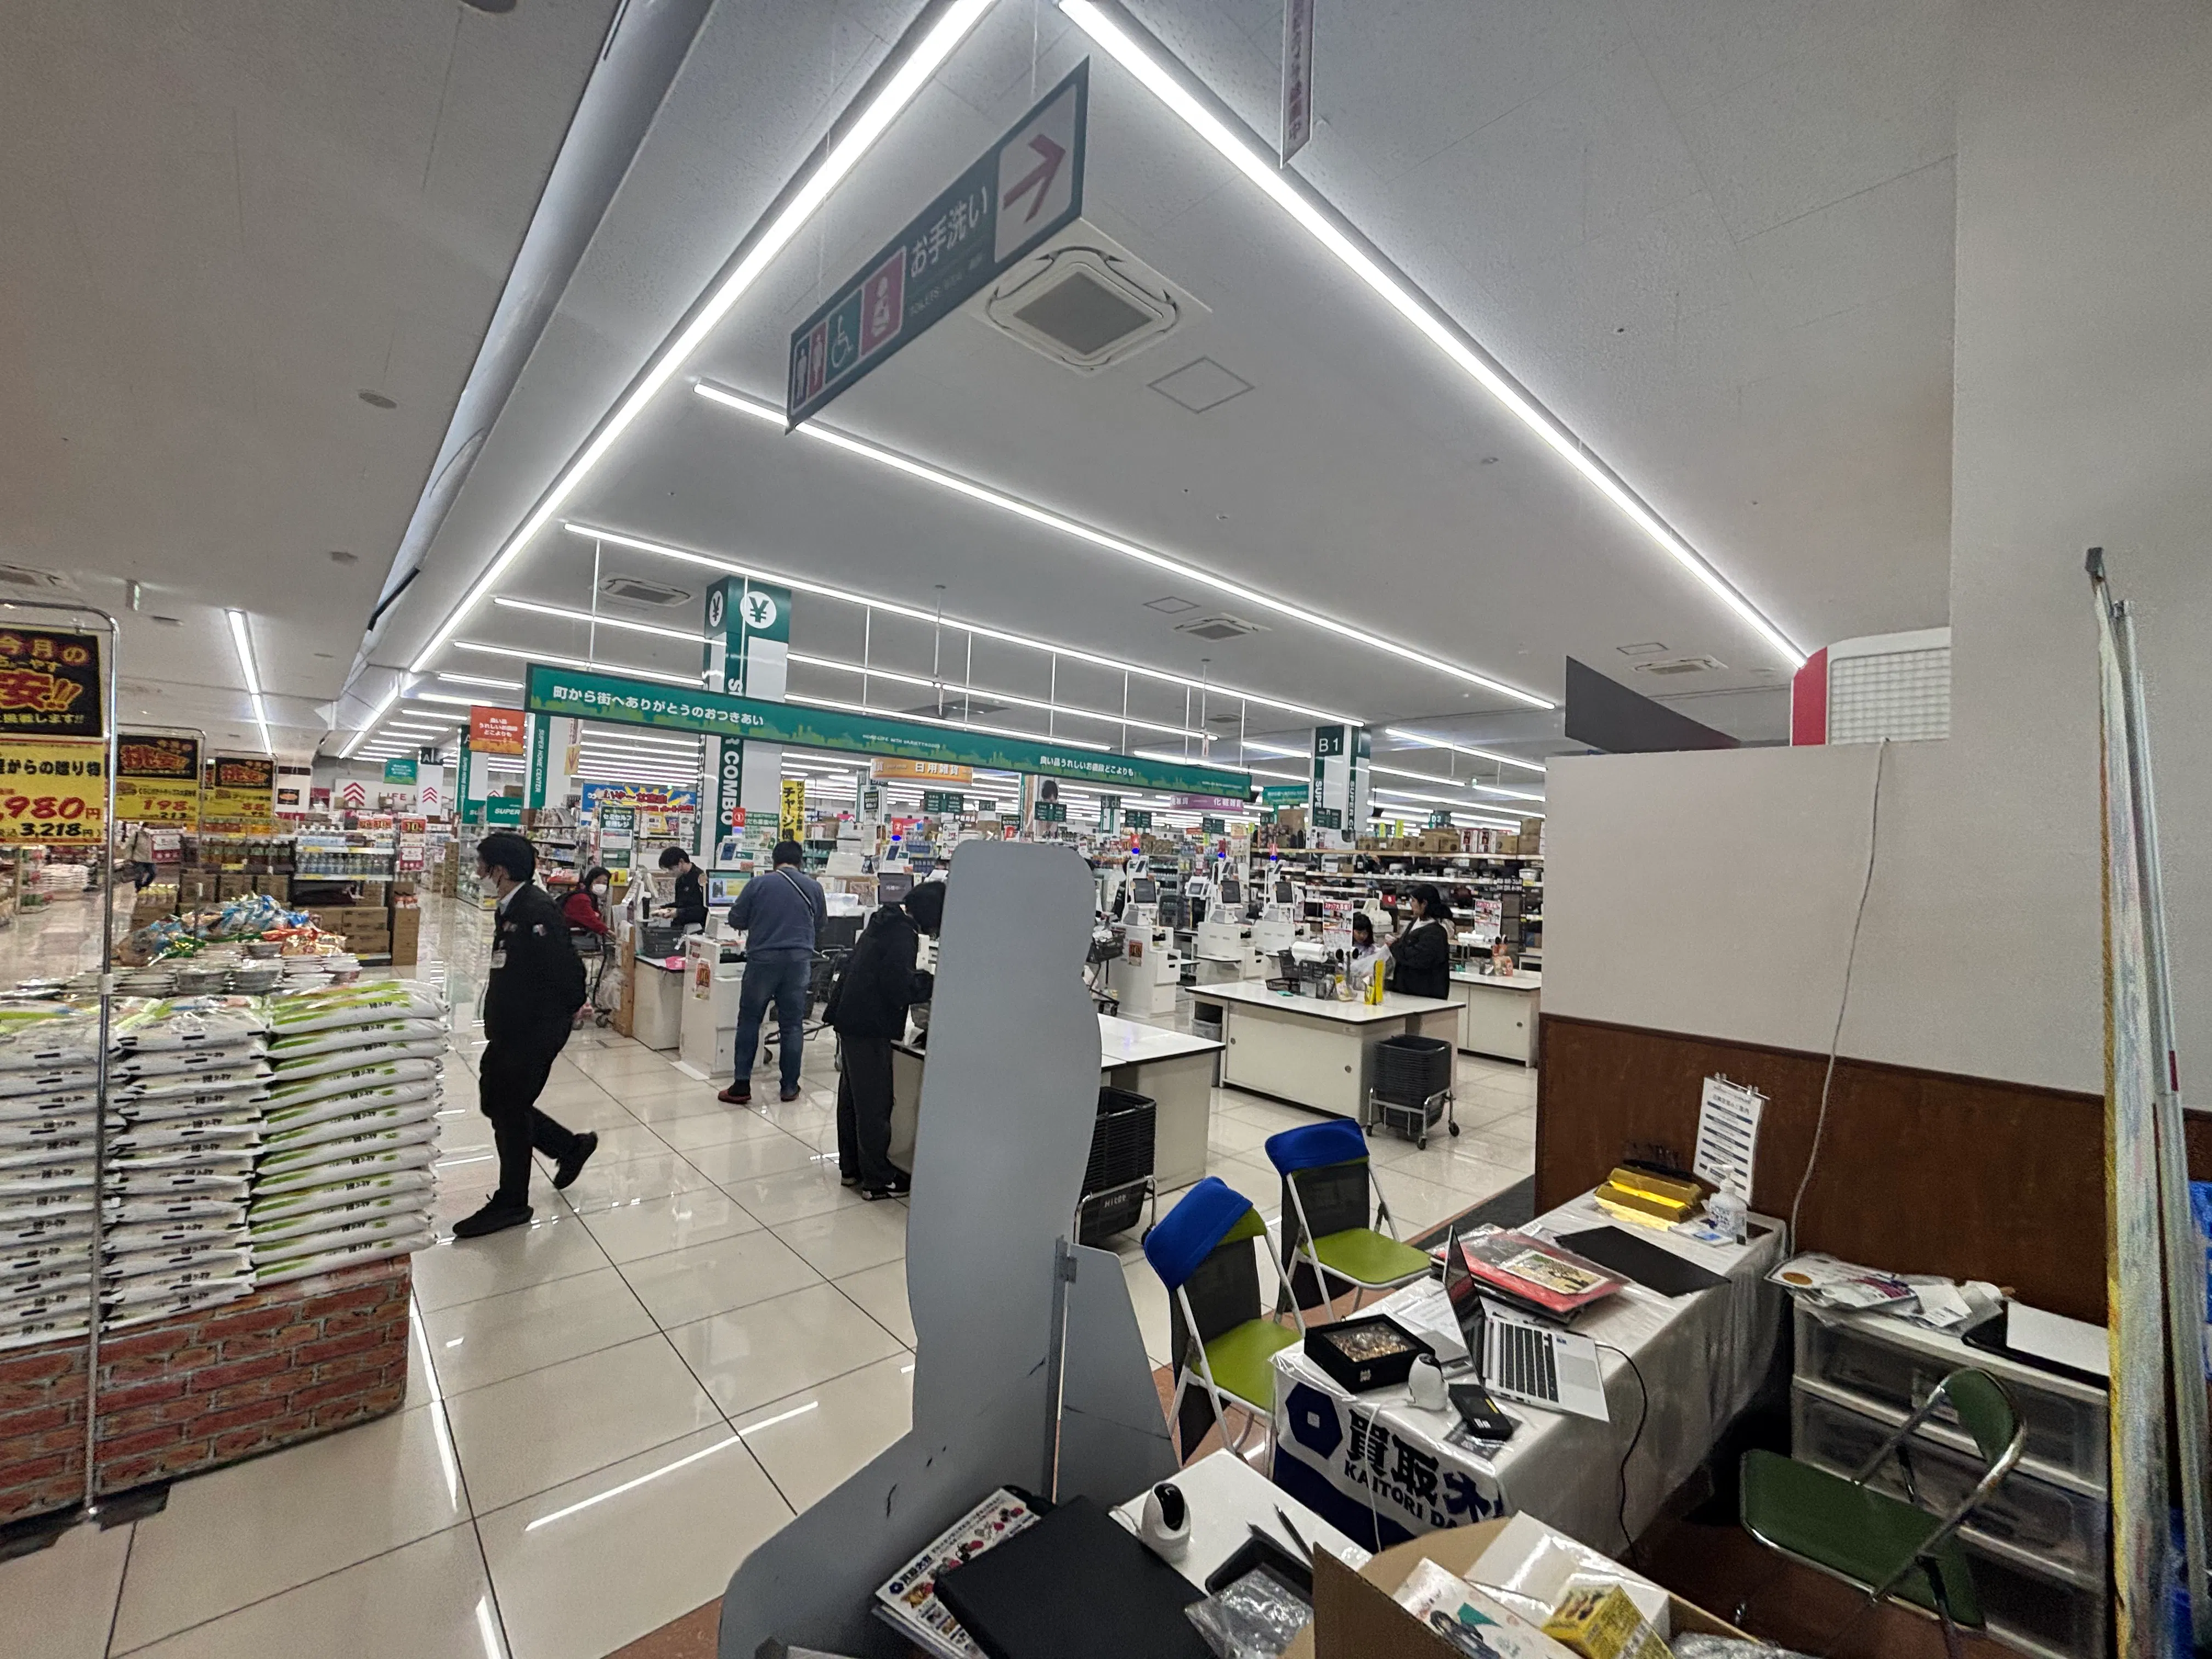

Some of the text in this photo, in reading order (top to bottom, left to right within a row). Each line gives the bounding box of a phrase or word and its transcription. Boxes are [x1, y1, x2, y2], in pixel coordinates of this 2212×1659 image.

[911, 185, 987, 278] お手洗い
[552, 685, 764, 726] 町から街へありがとうのおつきあい
[1318, 737, 1339, 752] B1
[720, 750, 740, 825] COMBO
[782, 787, 795, 840] チャージ機
[1344, 1459, 1423, 1519] KAITORI
